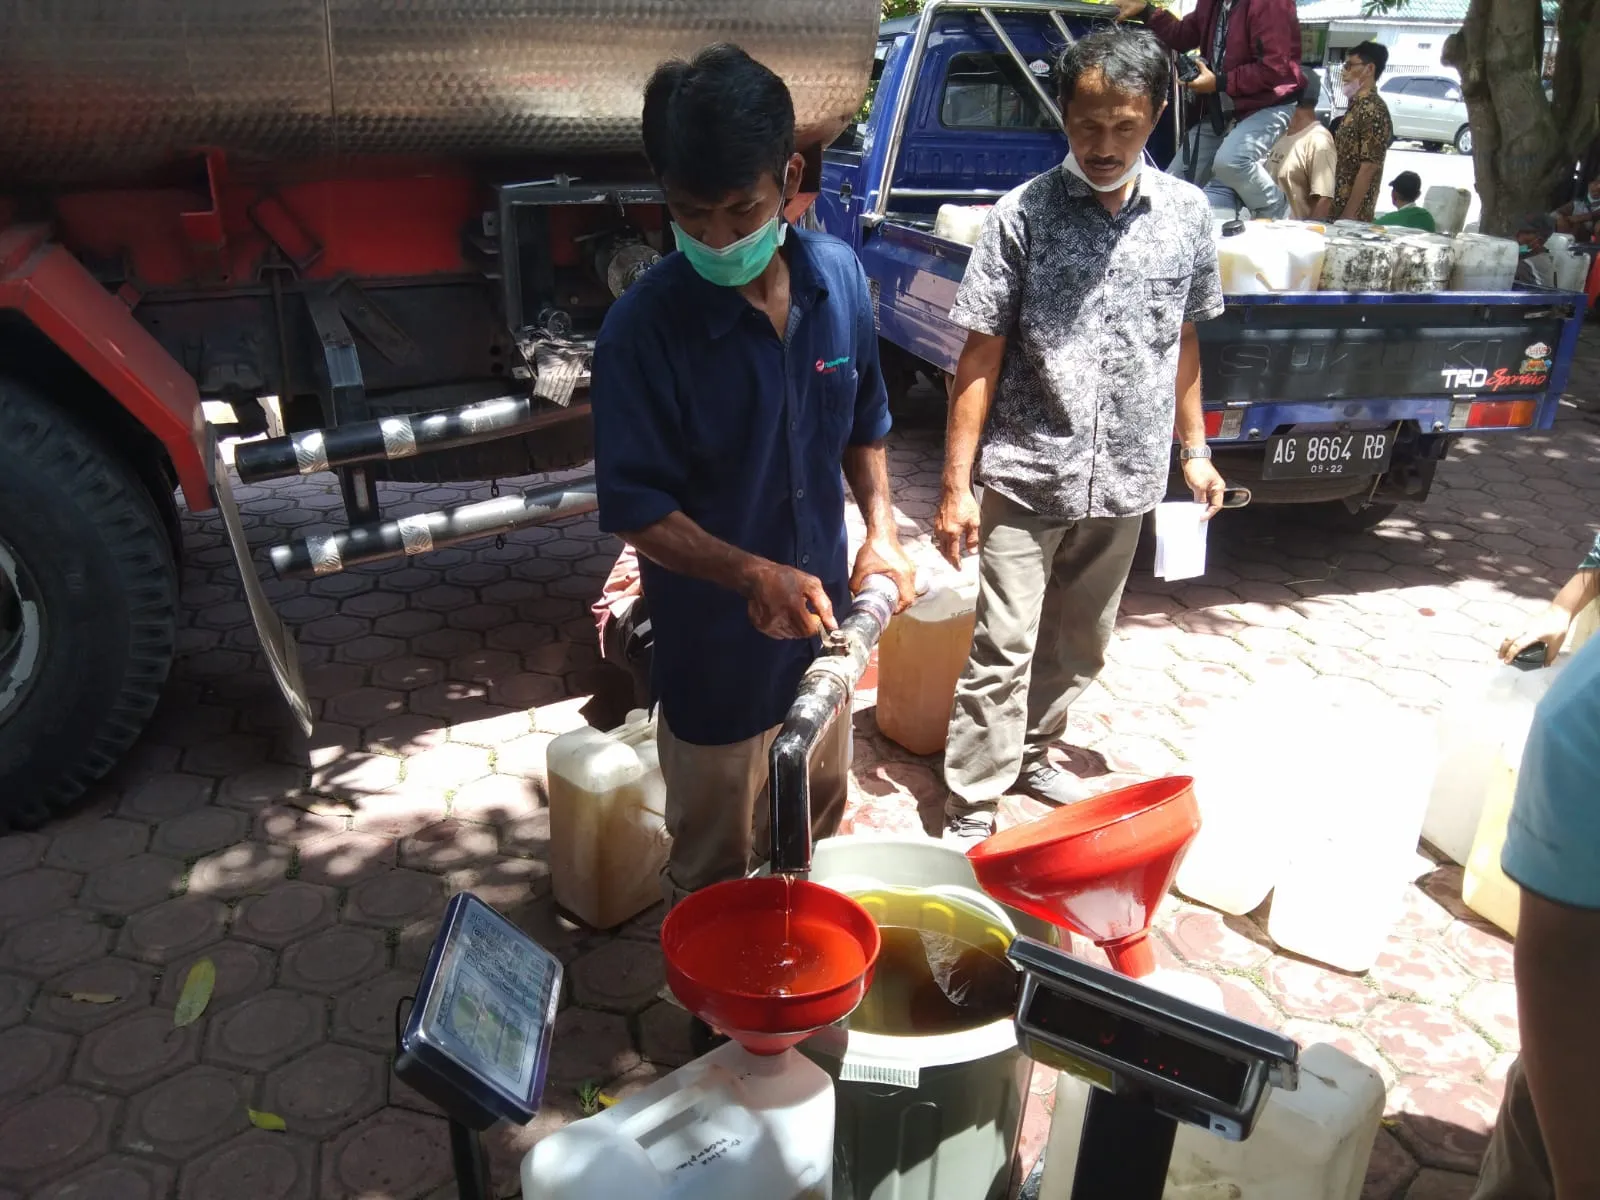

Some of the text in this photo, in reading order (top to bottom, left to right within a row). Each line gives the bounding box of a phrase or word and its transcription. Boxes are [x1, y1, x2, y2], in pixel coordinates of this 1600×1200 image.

[1441, 368, 1488, 389] TRD
[1272, 434, 1386, 464] AG 8664 RB
